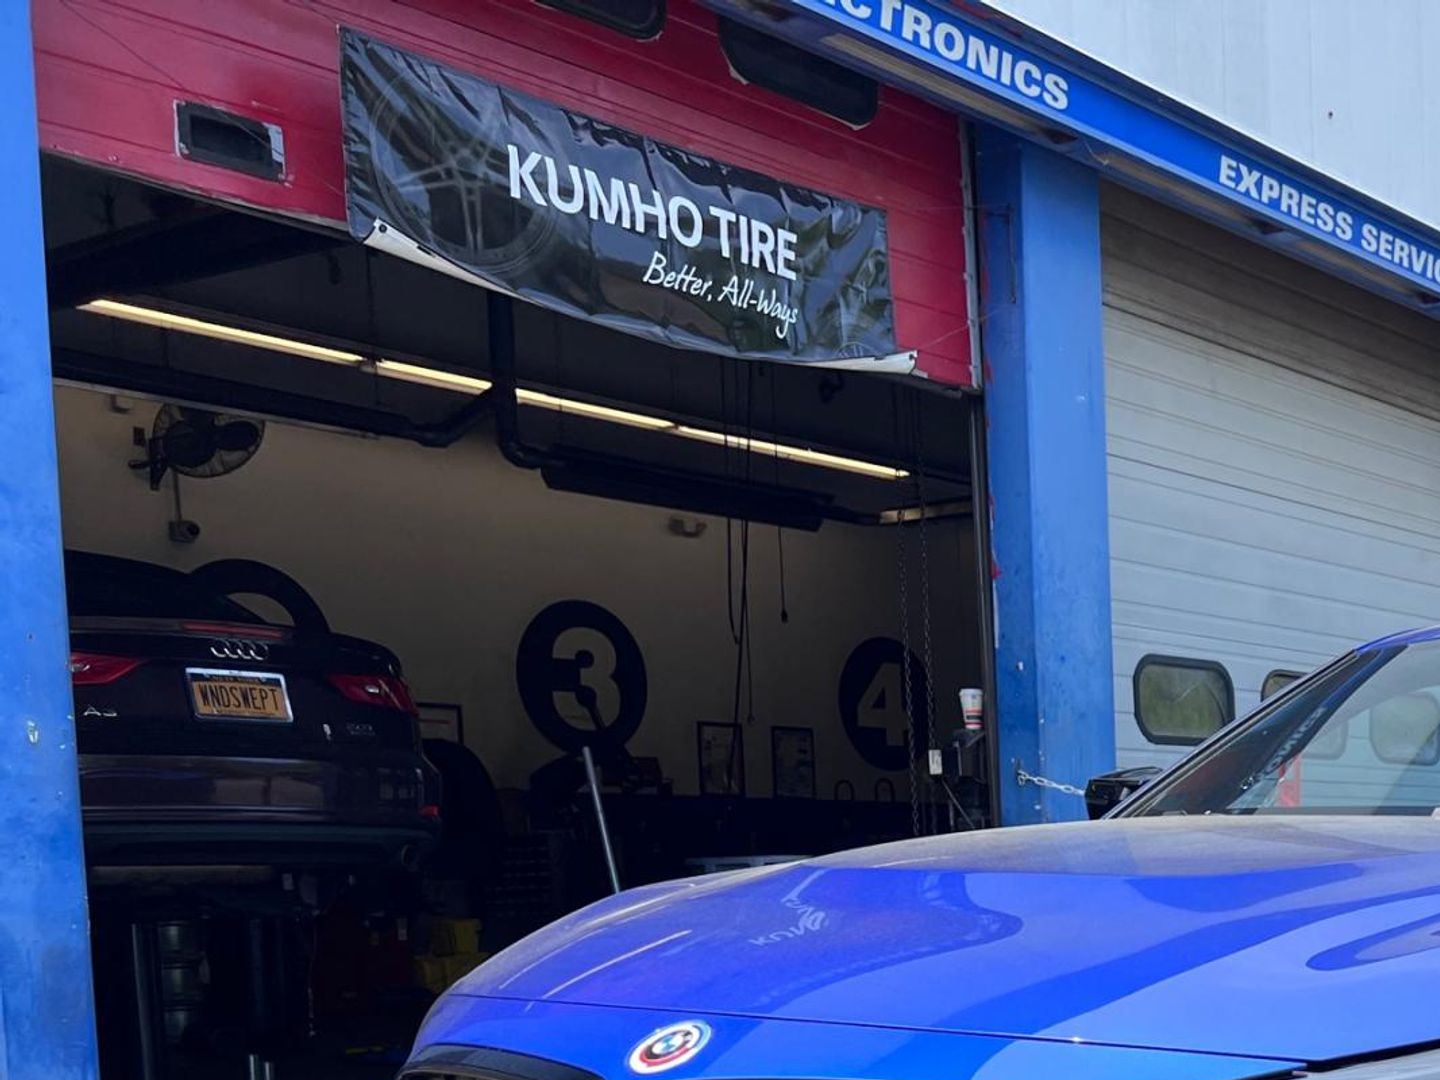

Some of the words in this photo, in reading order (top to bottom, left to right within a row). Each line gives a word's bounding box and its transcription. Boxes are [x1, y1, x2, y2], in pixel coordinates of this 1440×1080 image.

[818, 0, 1070, 111] CTRONICS
[507, 144, 704, 248] KUMHO
[709, 205, 798, 281] TIRE
[1218, 155, 1353, 242] EXPRESS
[642, 251, 713, 302] Better,
[717, 275, 799, 339] All-Ways
[199, 684, 279, 711] WNDSWEPT
[552, 626, 621, 731] 3
[857, 662, 911, 747] 4
